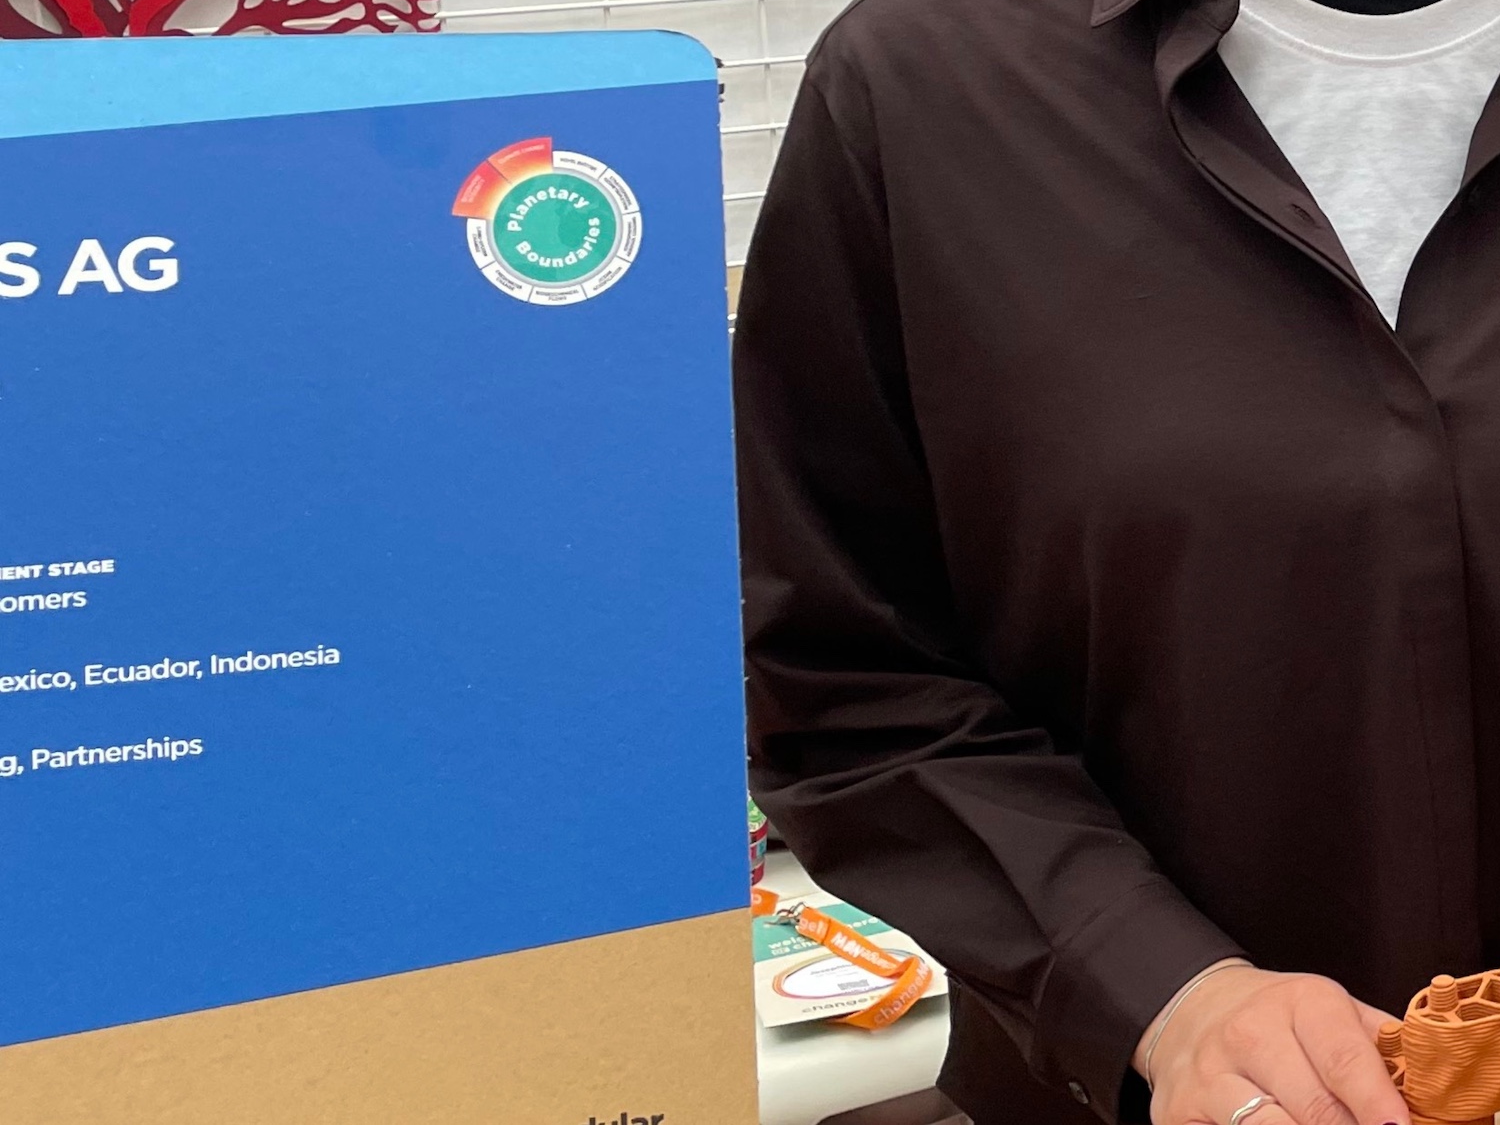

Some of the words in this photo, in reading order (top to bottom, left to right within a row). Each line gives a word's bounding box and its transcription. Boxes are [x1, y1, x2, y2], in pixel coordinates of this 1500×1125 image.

[507, 186, 590, 233] Planetary
[57, 236, 179, 295] AG
[515, 217, 601, 268] Boundaries
[47, 558, 115, 577] STAGE
[0, 590, 87, 613] omers
[0, 669, 77, 693] exico,
[84, 658, 203, 686] Ecuador,
[210, 644, 341, 675] Indonesia
[31, 736, 203, 770] Partnerships
